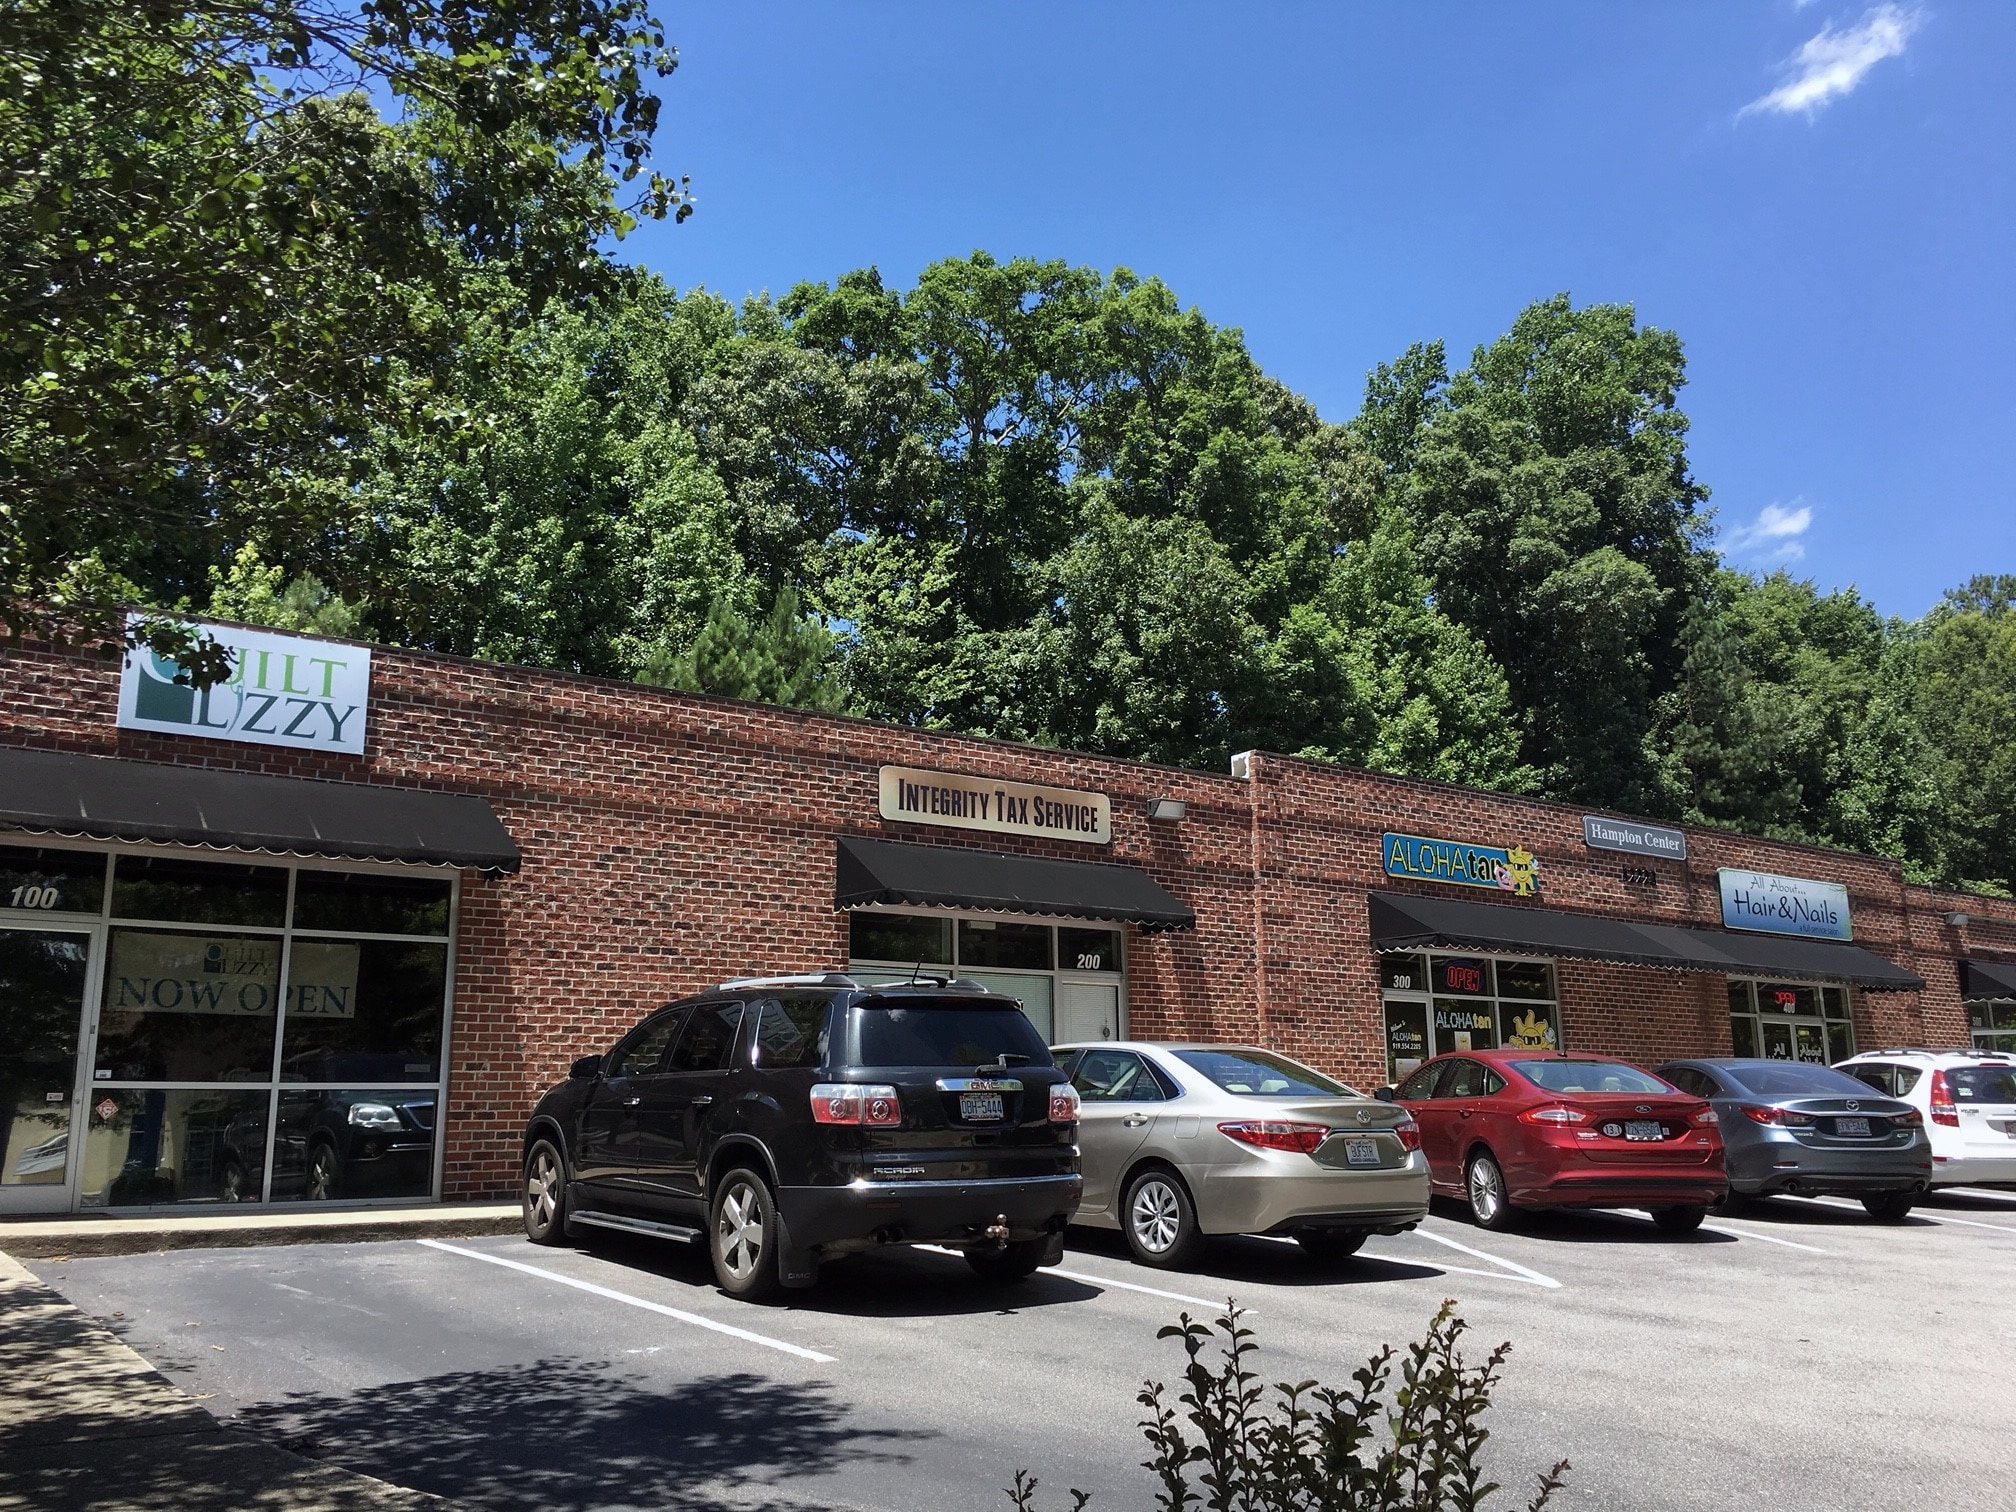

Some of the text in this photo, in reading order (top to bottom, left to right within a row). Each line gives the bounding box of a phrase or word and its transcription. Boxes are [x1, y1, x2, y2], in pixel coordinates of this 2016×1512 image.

[898, 778, 1098, 833] INTEGRITY TAX SERVICE
[1591, 823, 1680, 851] Hampton Center
[1750, 876, 1765, 889] All
[11, 886, 58, 909] 100
[1077, 954, 1101, 970] 200
[1393, 975, 1411, 989] 300
[1446, 966, 1480, 992] OPEN
[118, 977, 229, 1011] NOW
[1775, 991, 1797, 1005] OPEN
[1783, 1002, 1796, 1013] 400
[1972, 1016, 1982, 1027] 500
[1605, 1124, 1620, 1136] 13.1
[873, 1166, 926, 1175] ACADIA
